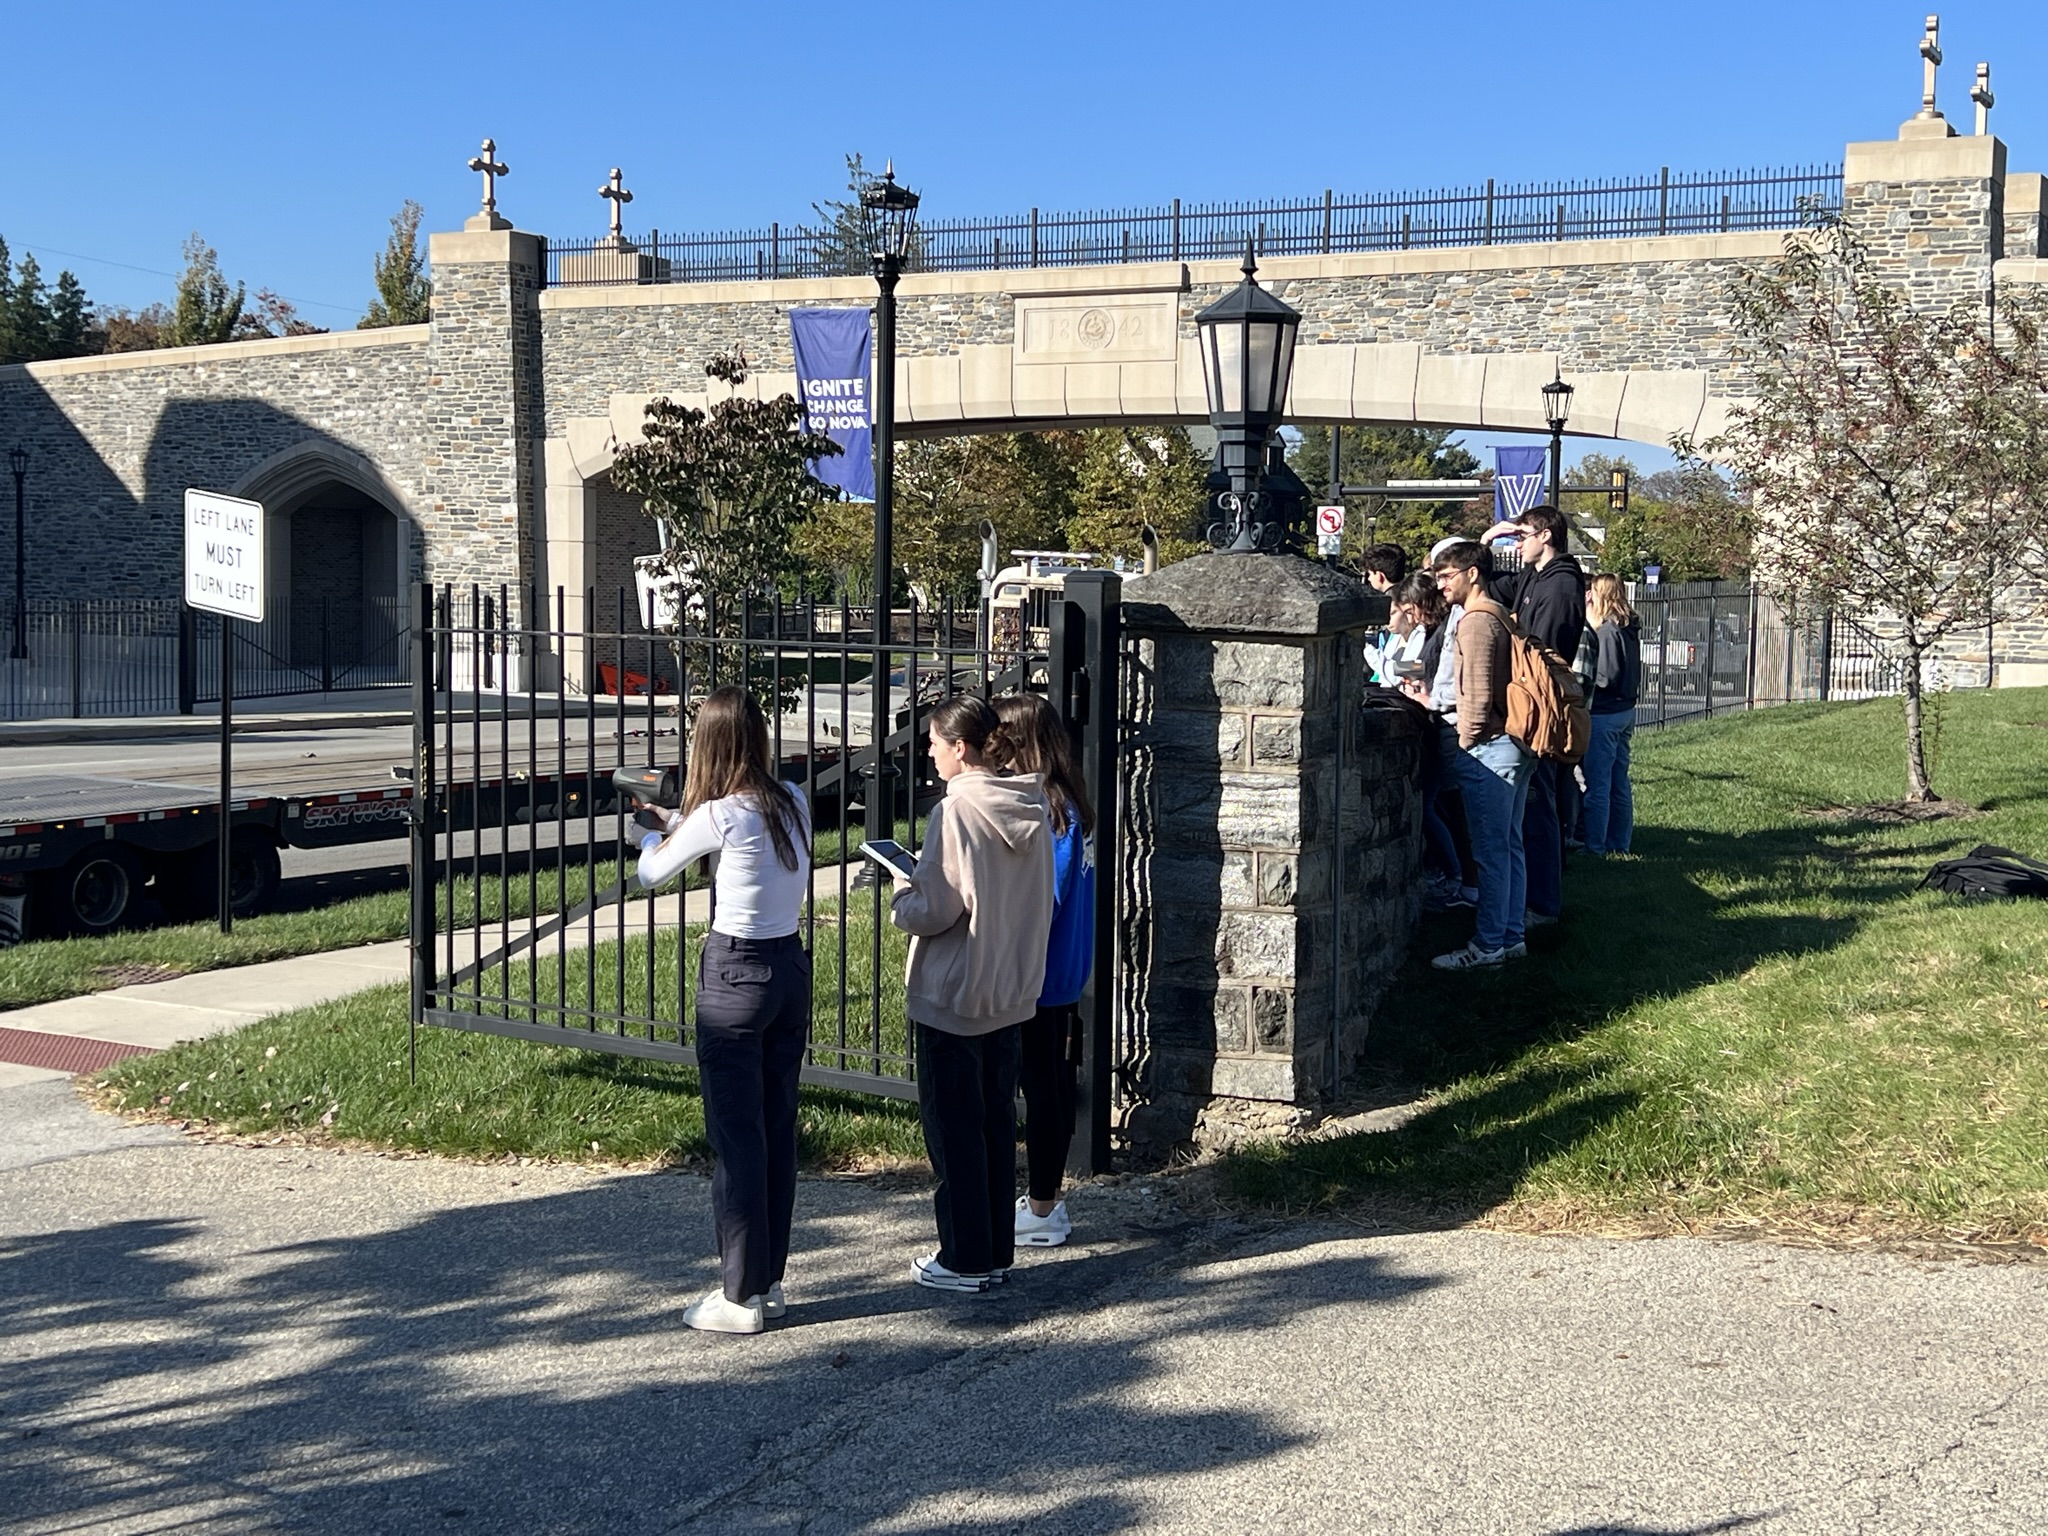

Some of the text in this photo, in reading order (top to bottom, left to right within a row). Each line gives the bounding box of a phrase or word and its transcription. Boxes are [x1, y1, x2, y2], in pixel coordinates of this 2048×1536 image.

[1049, 318, 1070, 340] 18
[1118, 315, 1143, 338] 42
[802, 378, 864, 397] IGNITE
[807, 398, 867, 414] CHANGE.
[808, 415, 827, 430] GO
[1498, 474, 1543, 519] V
[194, 507, 255, 536] LEFT LANE
[206, 541, 242, 569] MUST
[194, 573, 255, 603] TURN LEFT
